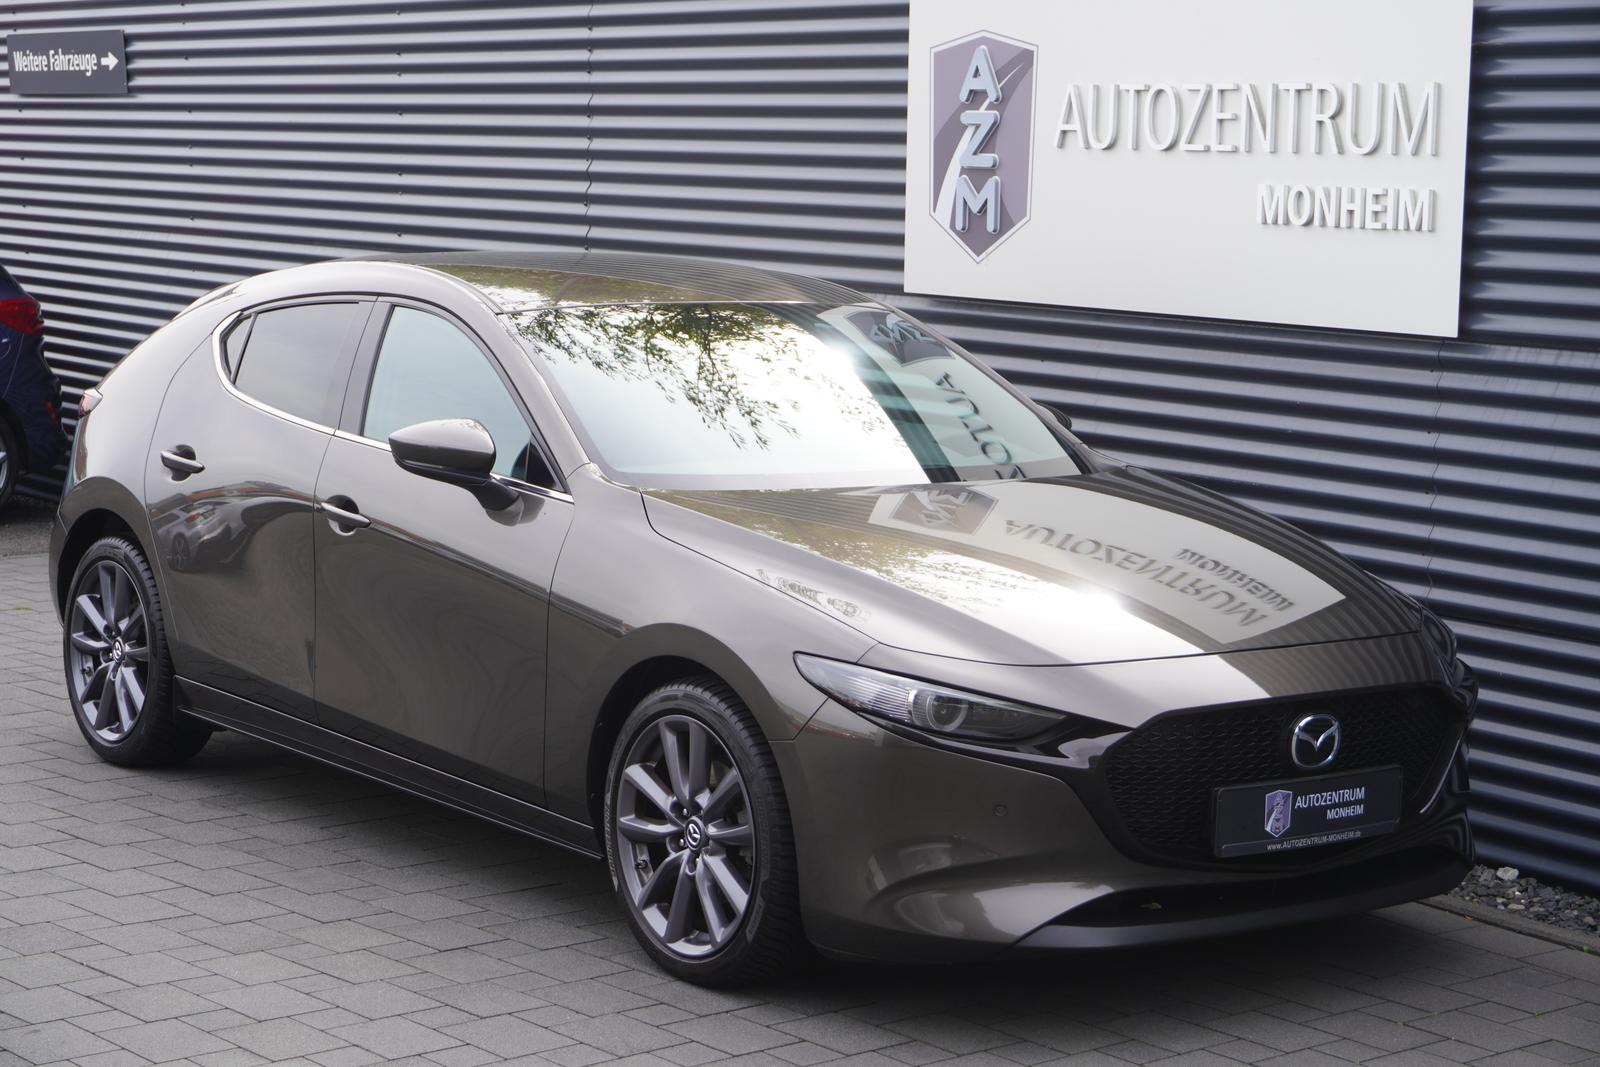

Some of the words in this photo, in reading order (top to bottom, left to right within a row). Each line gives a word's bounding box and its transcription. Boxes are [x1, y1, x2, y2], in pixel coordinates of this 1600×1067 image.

[13, 50, 47, 71] Weitere
[49, 48, 97, 76] Fahrzeuge
[1055, 82, 1440, 156] AUTOZENTRUM
[955, 45, 1002, 233] AZM
[1257, 184, 1436, 231] MONHEIM
[1295, 786, 1365, 809] AUTOZENTRUM
[1326, 804, 1364, 820] MONHEIM
